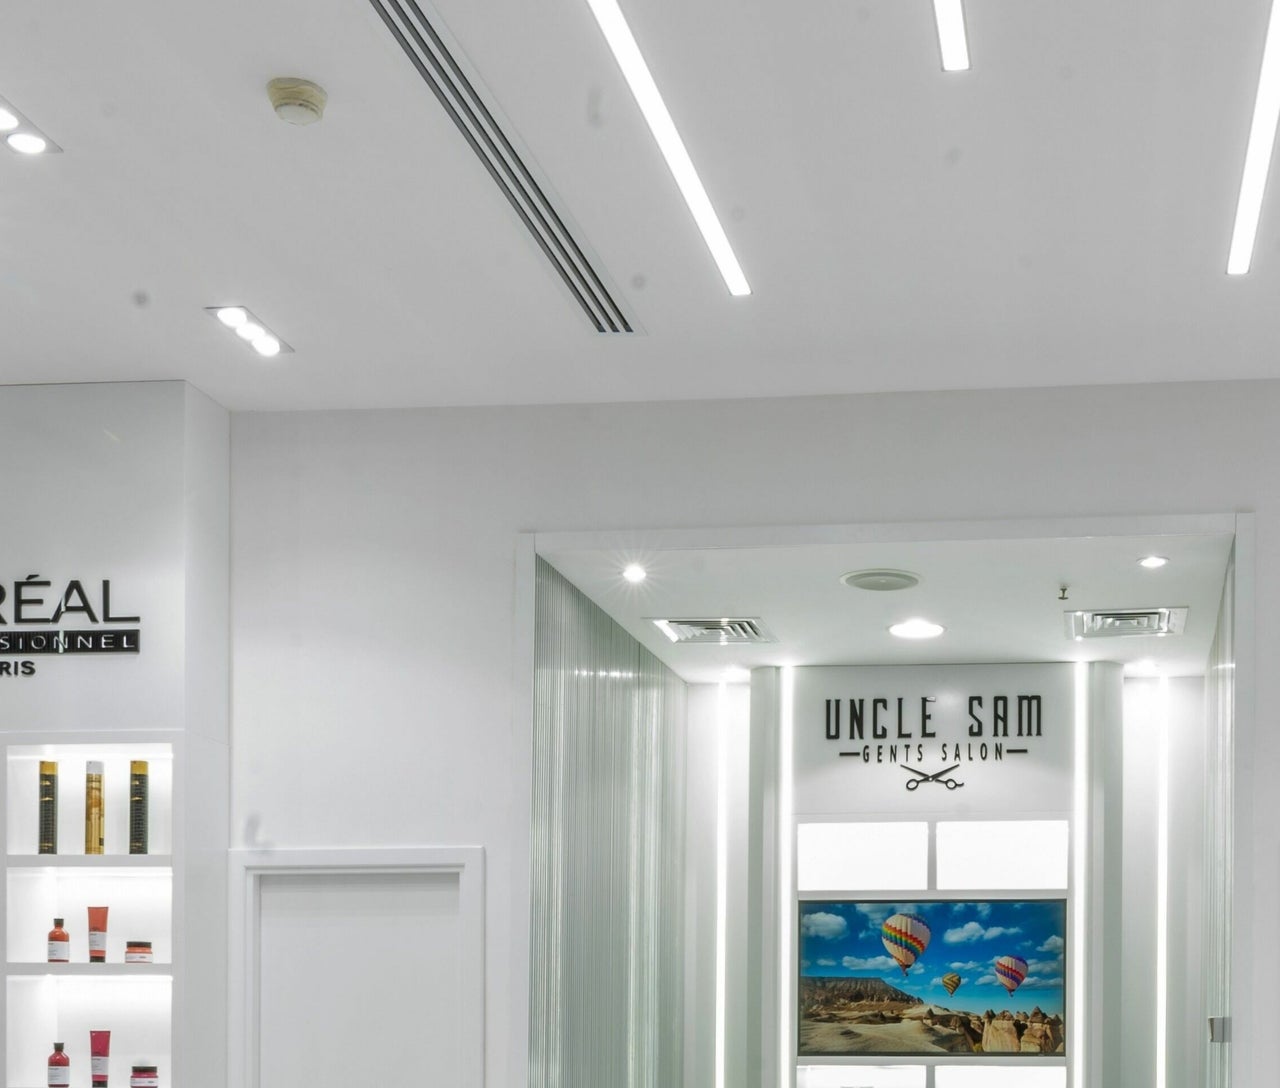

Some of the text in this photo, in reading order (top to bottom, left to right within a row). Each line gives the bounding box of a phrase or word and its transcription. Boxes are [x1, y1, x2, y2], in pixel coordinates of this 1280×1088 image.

[825, 695, 1043, 740] UNCLE SAM
[862, 742, 1004, 763] GENTS SALON
